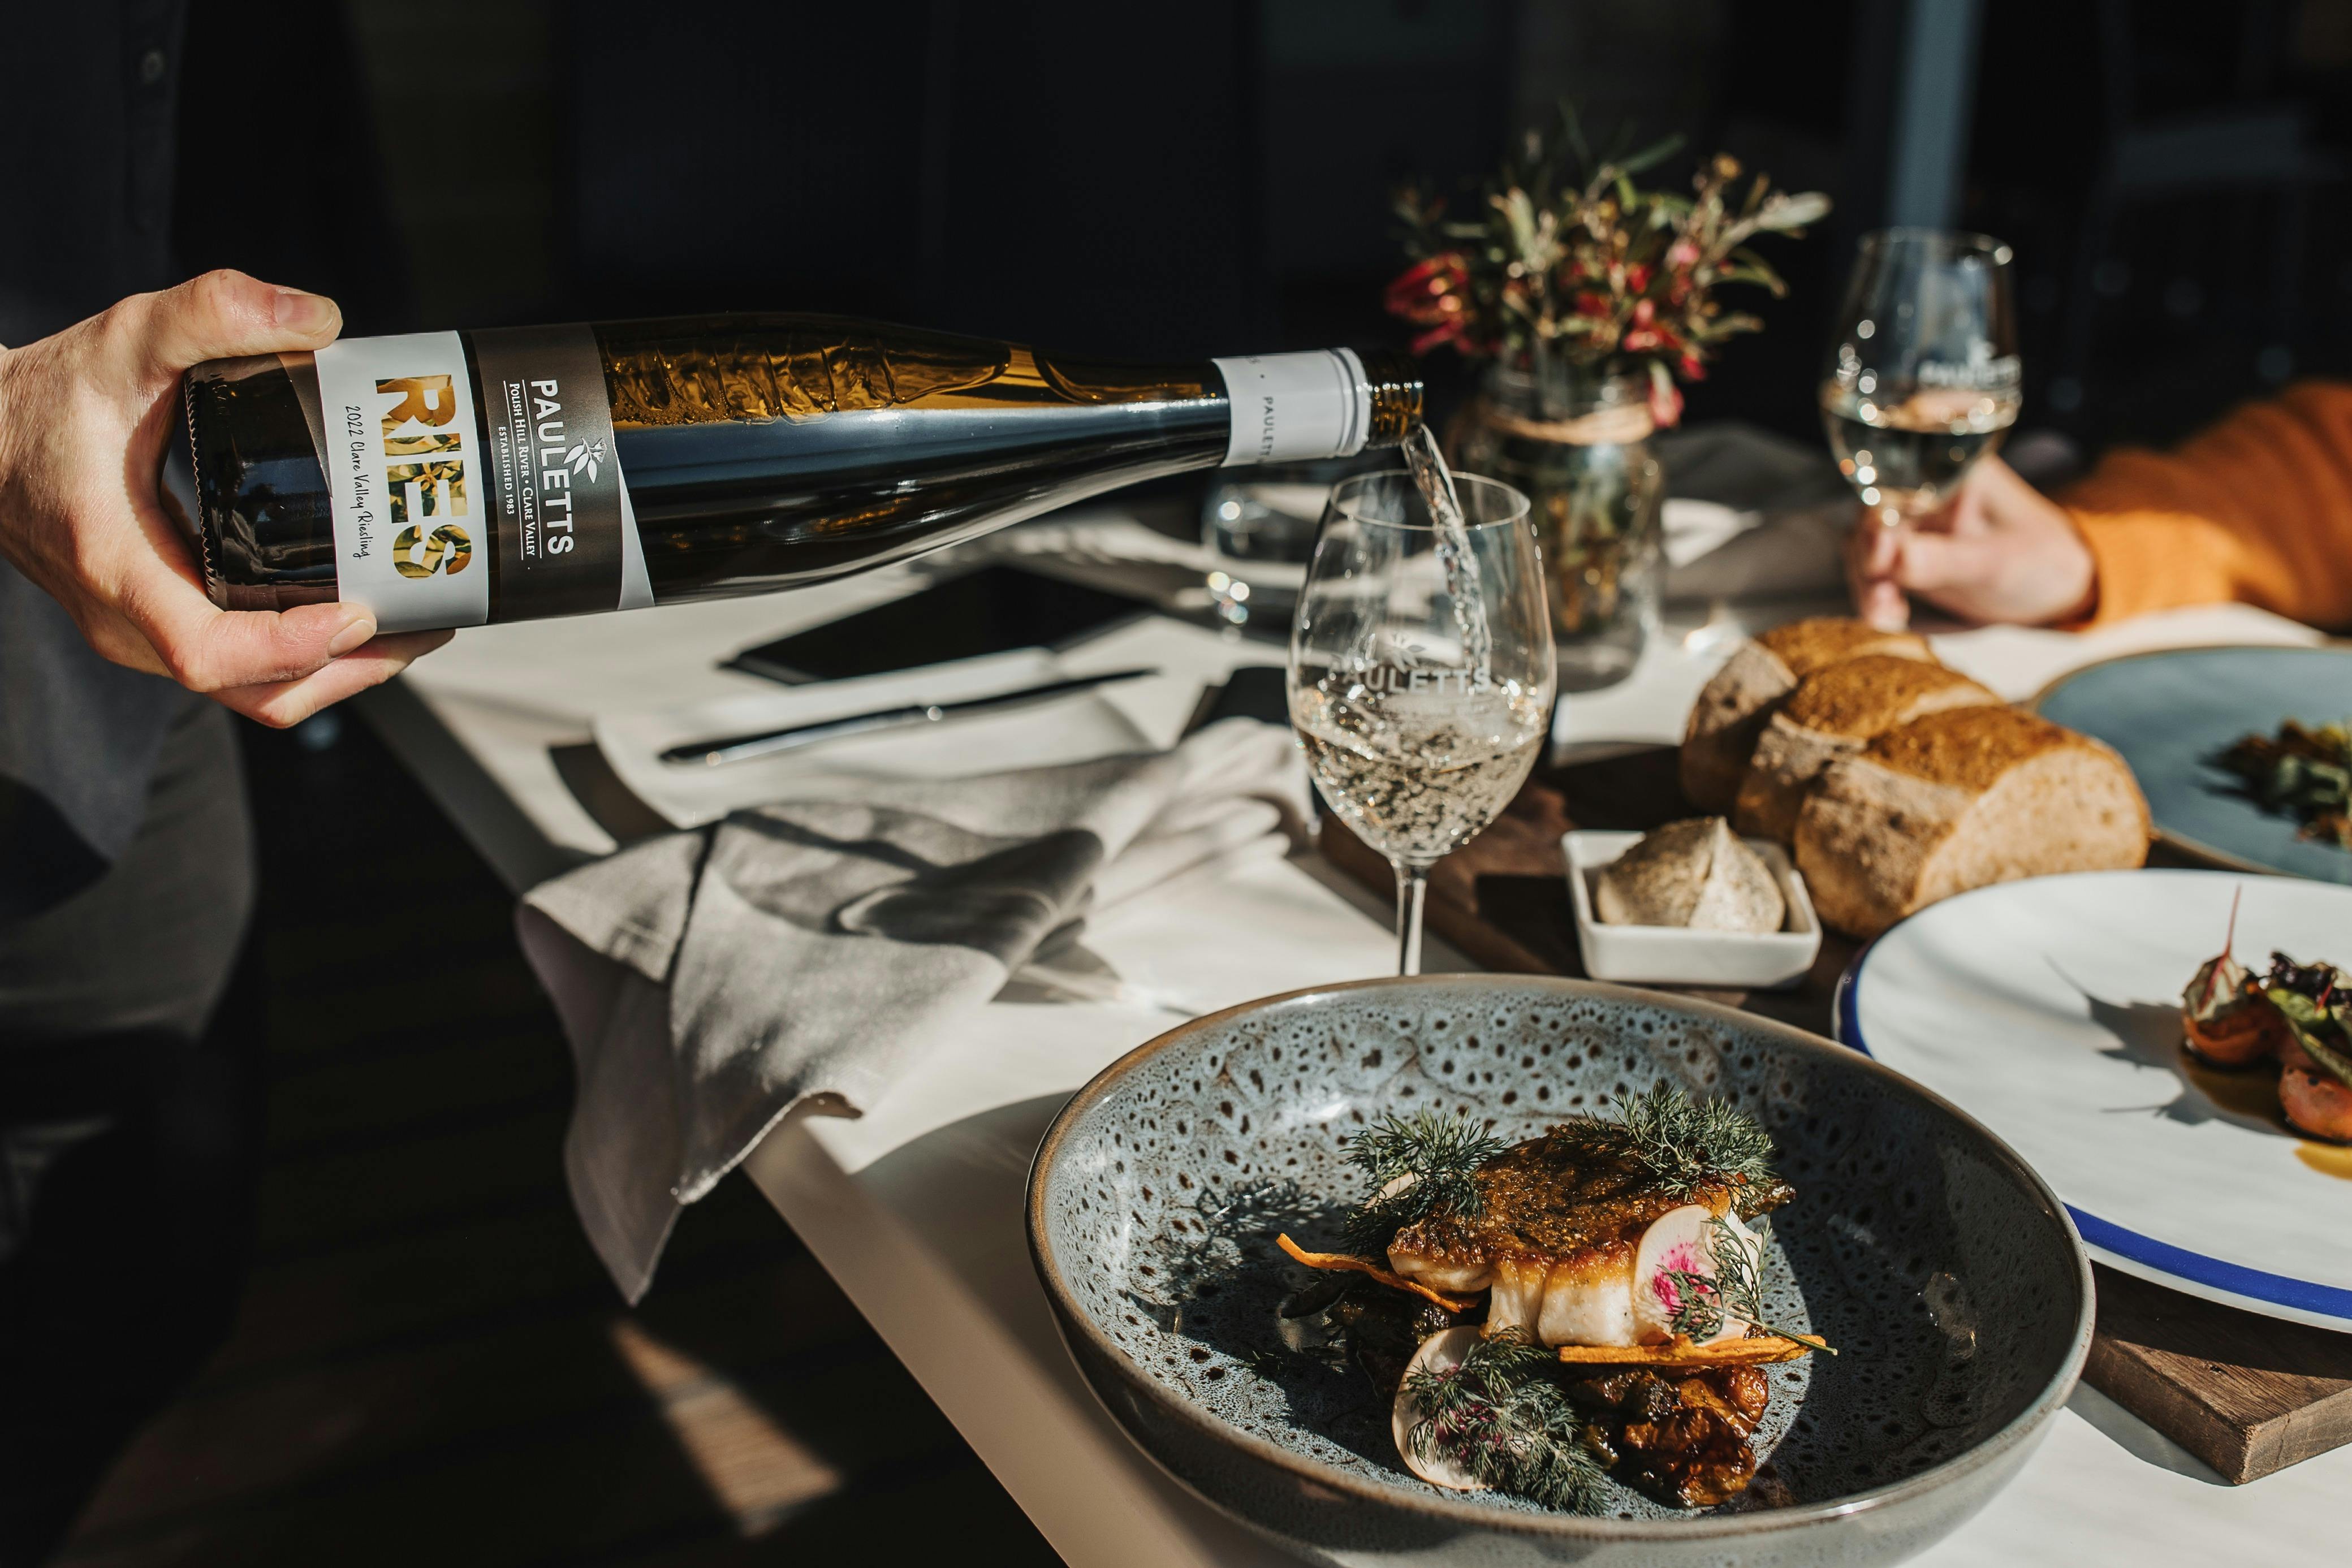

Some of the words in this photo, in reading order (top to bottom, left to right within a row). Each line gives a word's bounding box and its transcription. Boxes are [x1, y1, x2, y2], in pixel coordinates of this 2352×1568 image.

[345, 405, 364, 438] 2022
[350, 441, 365, 472] Clare
[376, 374, 472, 580] RIES
[498, 426, 512, 490] ESTABLISHED
[506, 494, 515, 515] 1983
[531, 379, 573, 554] PAULETTS
[349, 474, 370, 509] Valley
[352, 511, 374, 560] Riesling
